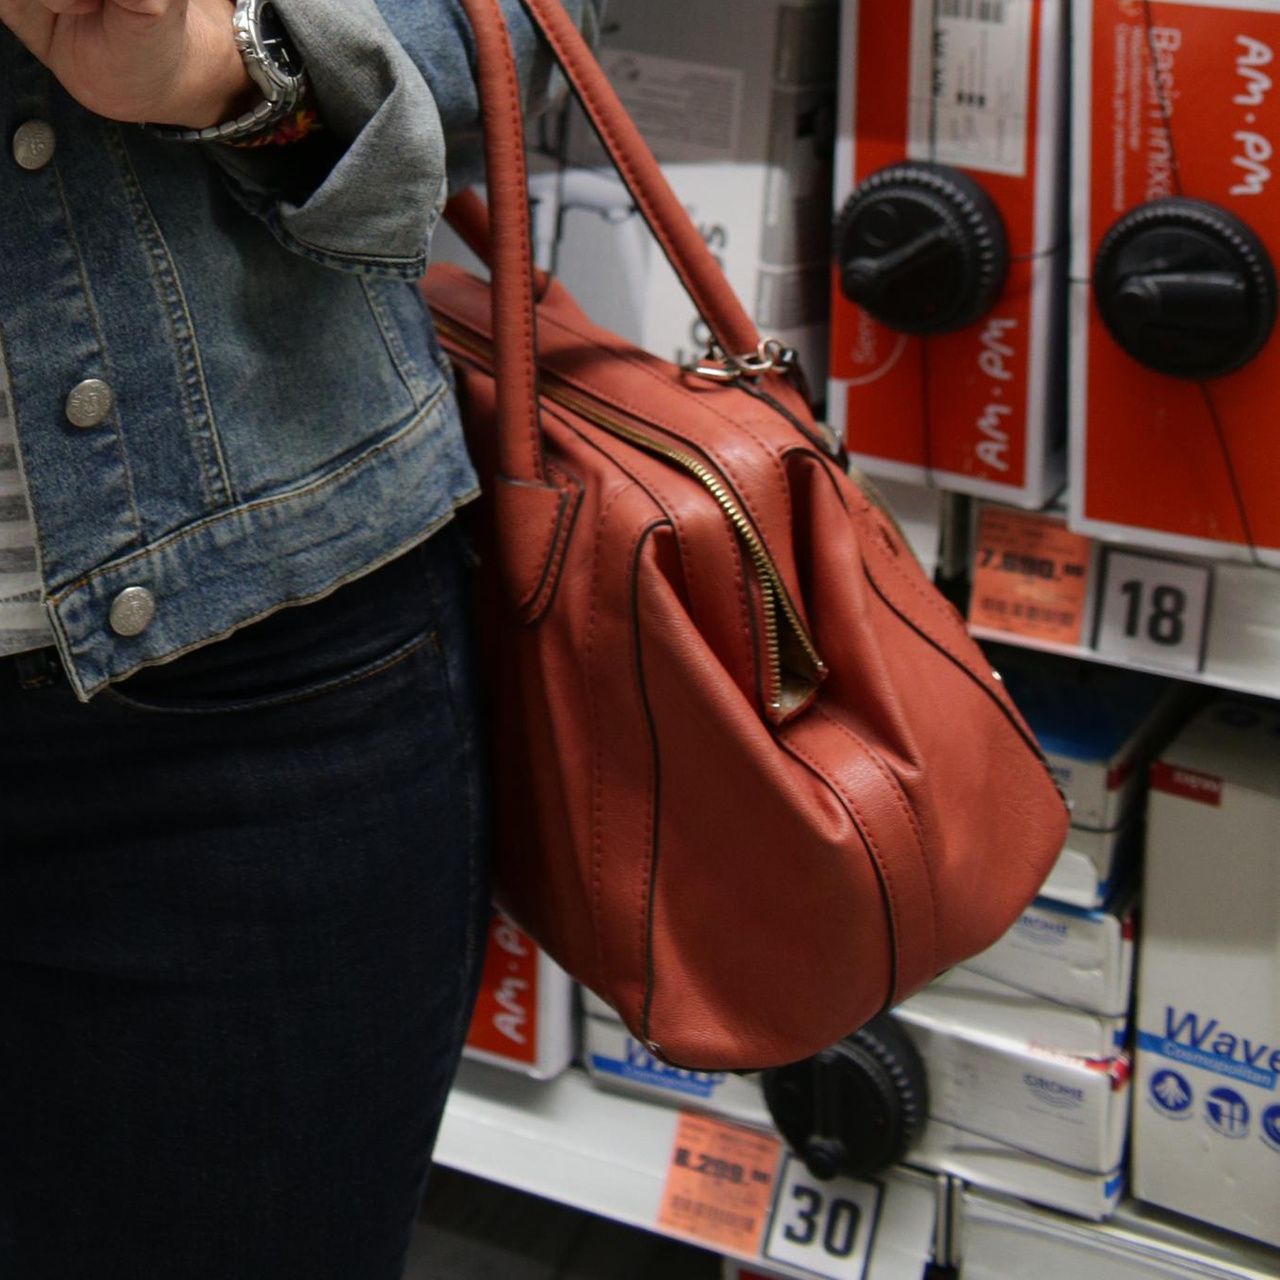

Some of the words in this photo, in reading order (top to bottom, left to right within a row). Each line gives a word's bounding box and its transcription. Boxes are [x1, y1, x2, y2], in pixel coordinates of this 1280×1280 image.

[1146, 126, 1178, 202] mixe
[1121, 579, 1187, 648] 18
[1165, 1004, 1280, 1075] Wave
[783, 1184, 862, 1259] 30
